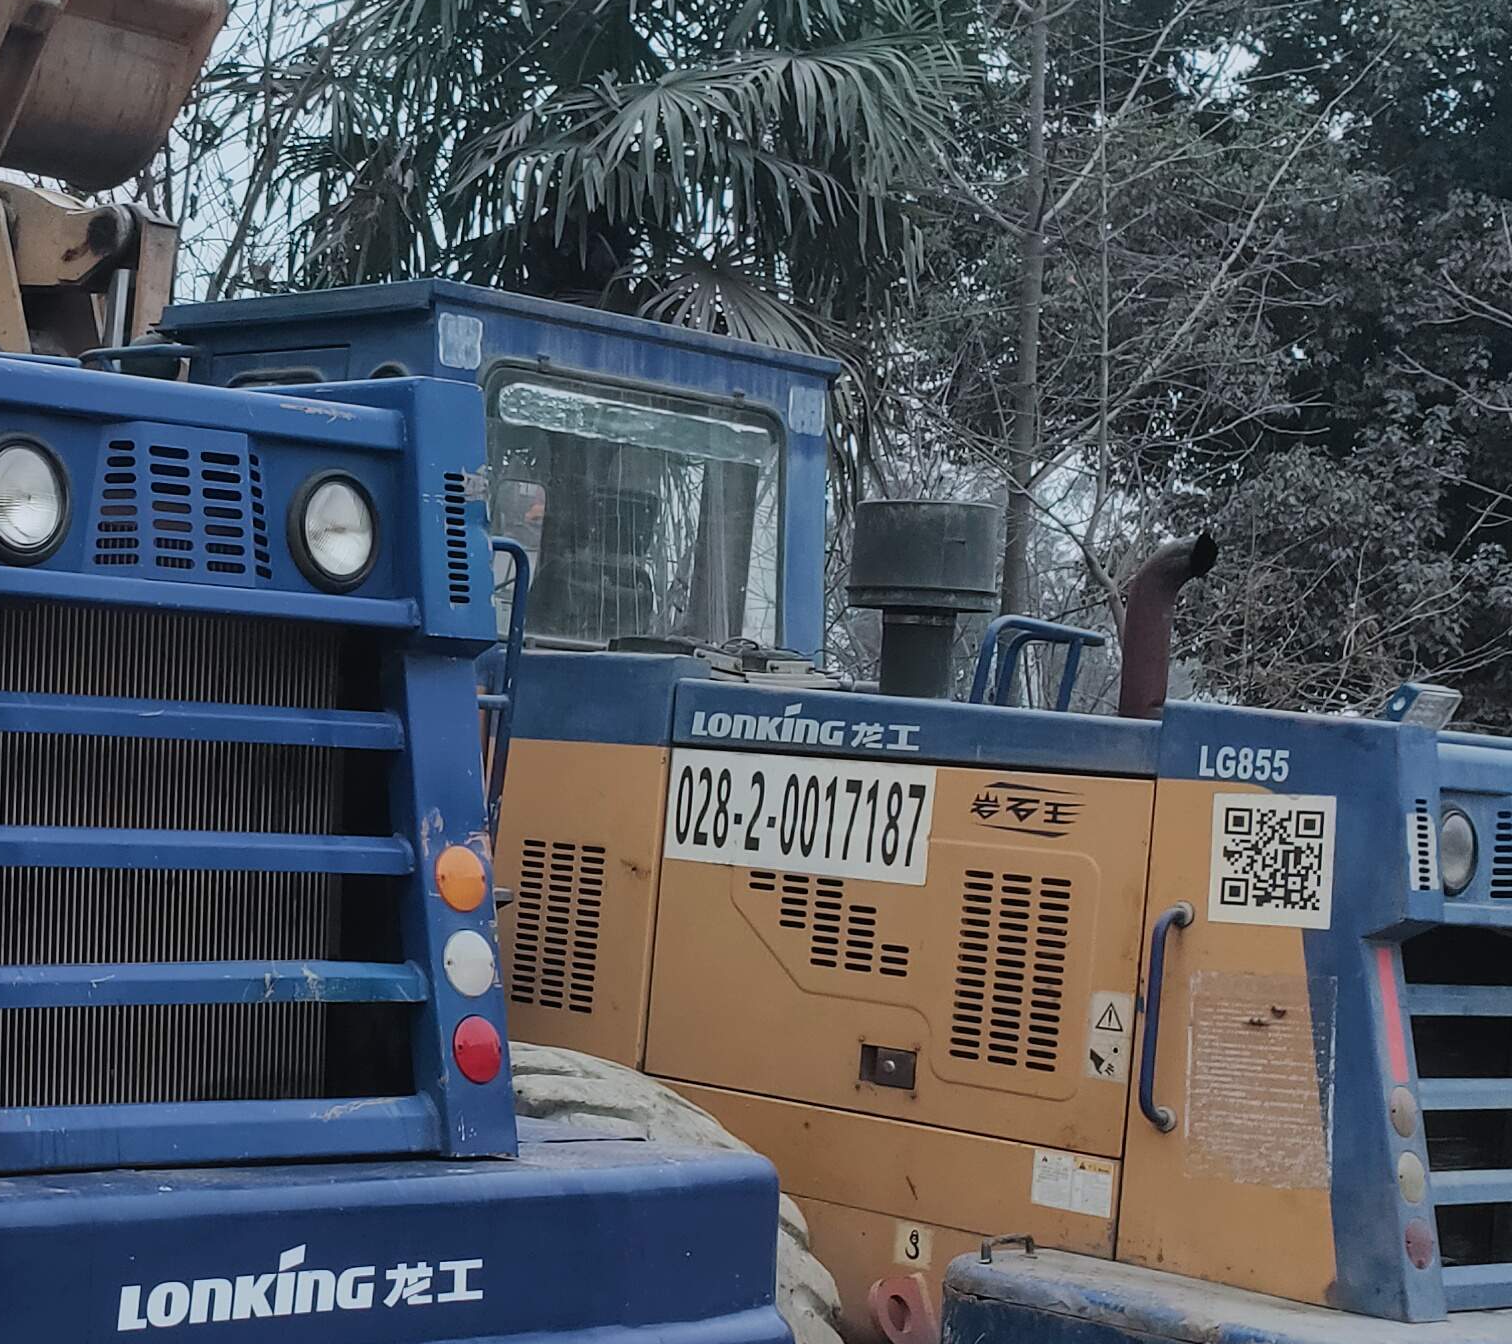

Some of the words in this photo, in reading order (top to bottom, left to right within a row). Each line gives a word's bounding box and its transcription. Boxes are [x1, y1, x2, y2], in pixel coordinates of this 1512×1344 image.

[850, 721, 921, 752] 龙工
[1198, 745, 1290, 782] LG855
[675, 765, 927, 868] 028-2-0017187
[970, 791, 1087, 825] 岩石王
[383, 1258, 484, 1309] 龙工
